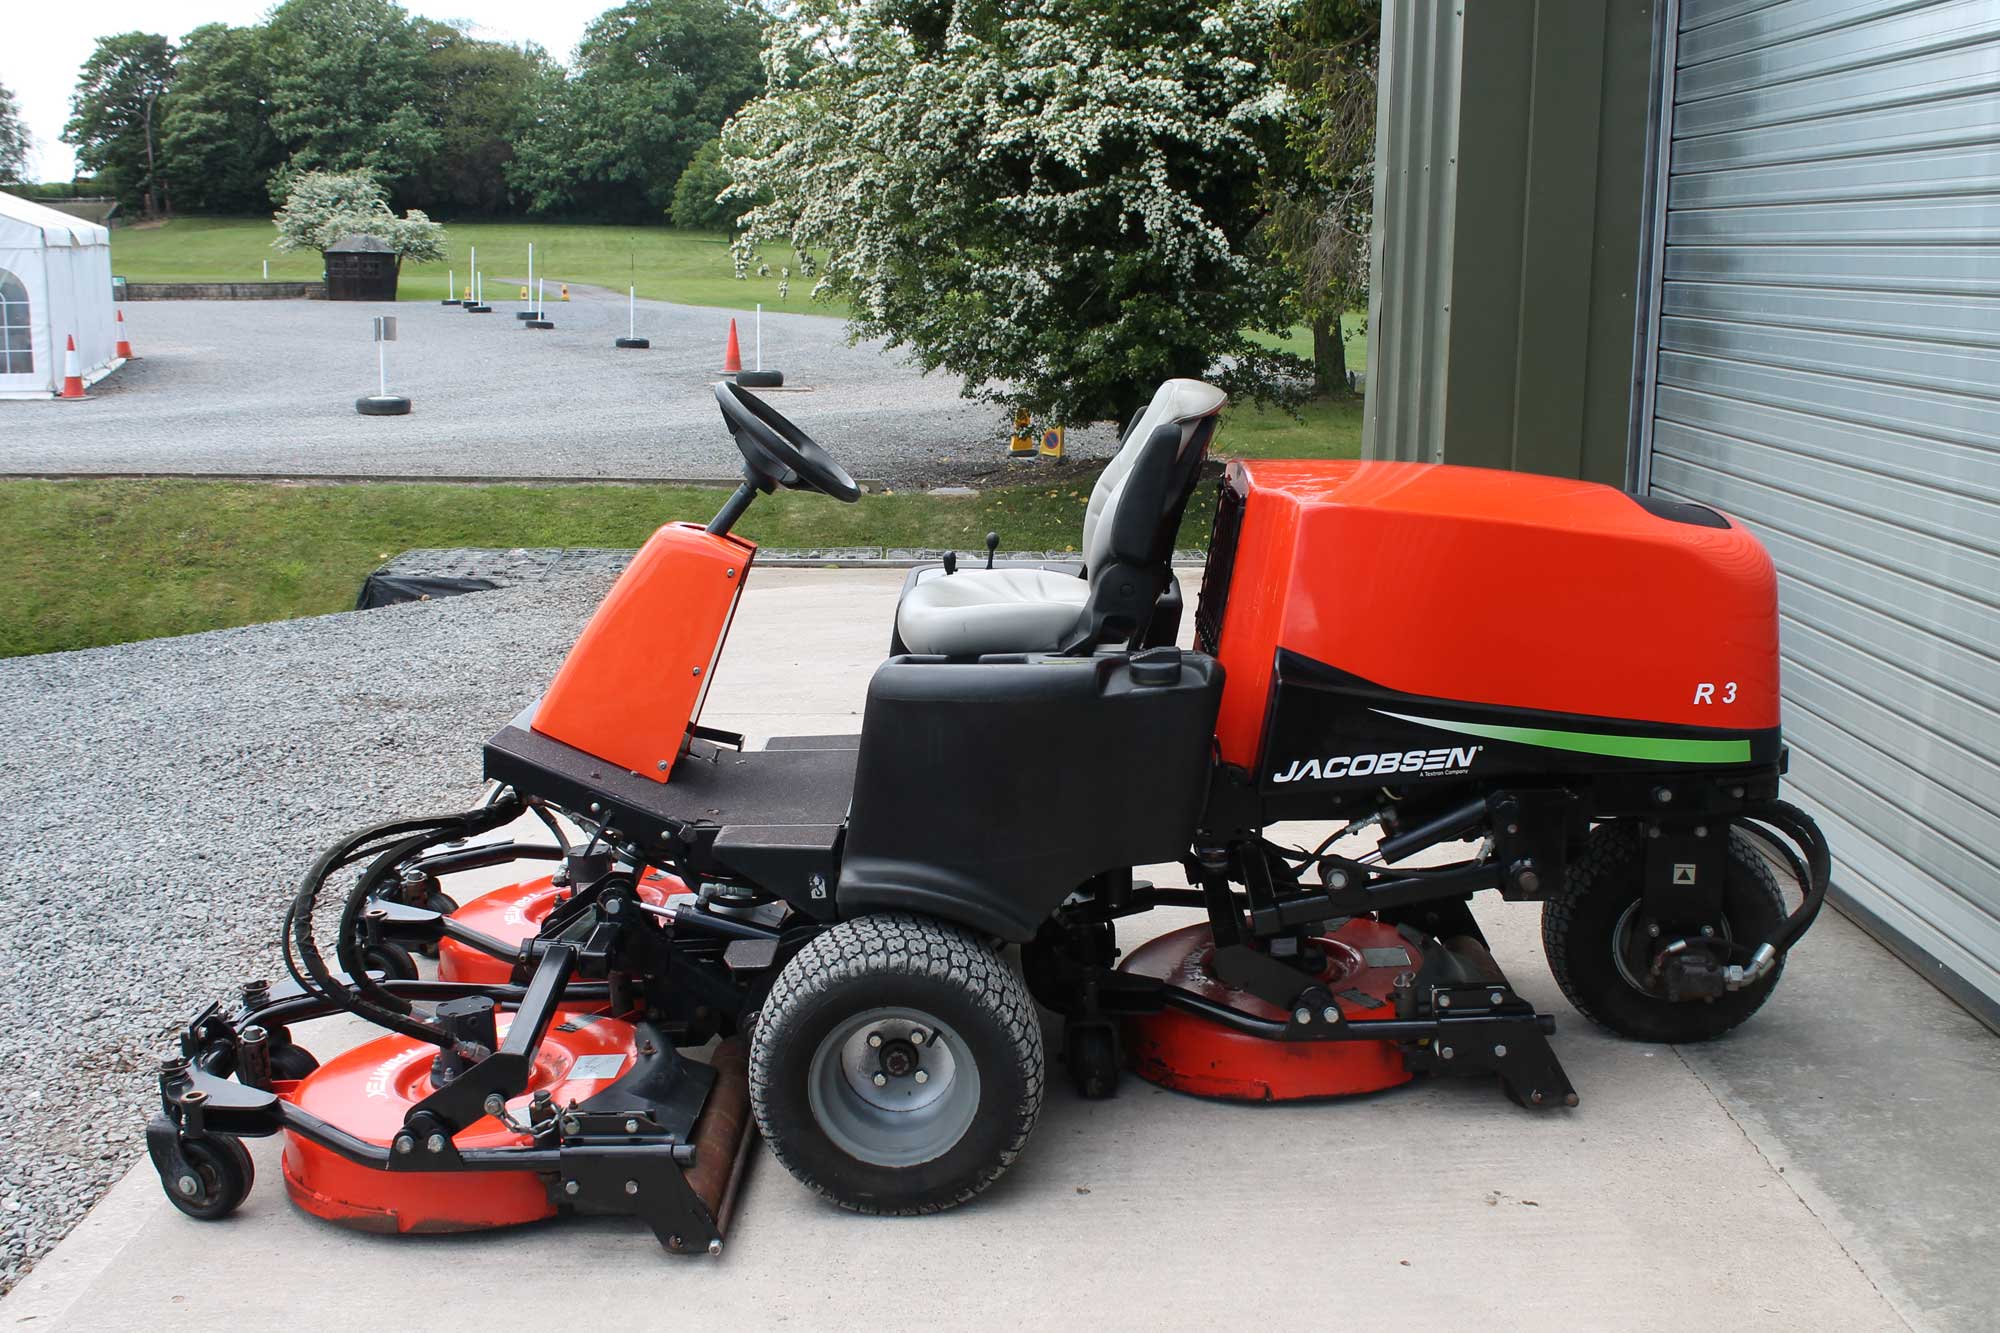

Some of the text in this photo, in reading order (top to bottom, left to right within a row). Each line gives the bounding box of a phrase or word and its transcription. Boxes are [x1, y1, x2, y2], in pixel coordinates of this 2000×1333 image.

[1693, 681, 1738, 705] R 3
[1272, 746, 1478, 783] JACOBSEN
